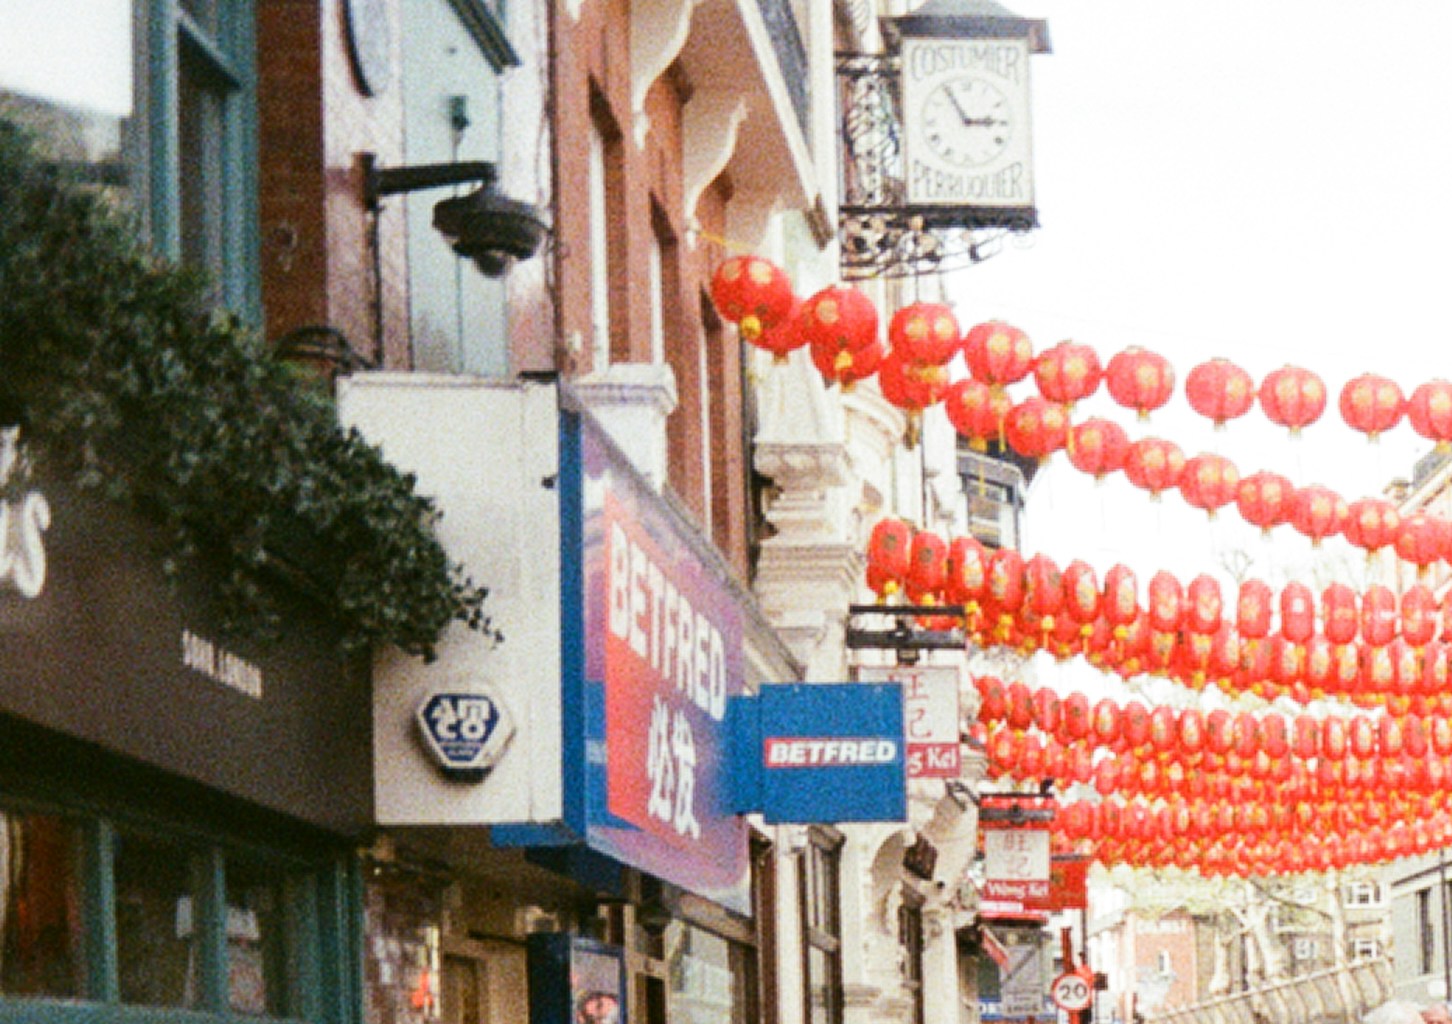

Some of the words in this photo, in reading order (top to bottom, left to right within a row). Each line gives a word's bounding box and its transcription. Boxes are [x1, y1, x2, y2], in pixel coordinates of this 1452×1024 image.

[910, 44, 1020, 84] COSTUMIER
[608, 519, 727, 722] BETFRED
[768, 738, 897, 764] BETFRED
[1059, 981, 1088, 1001] 20
